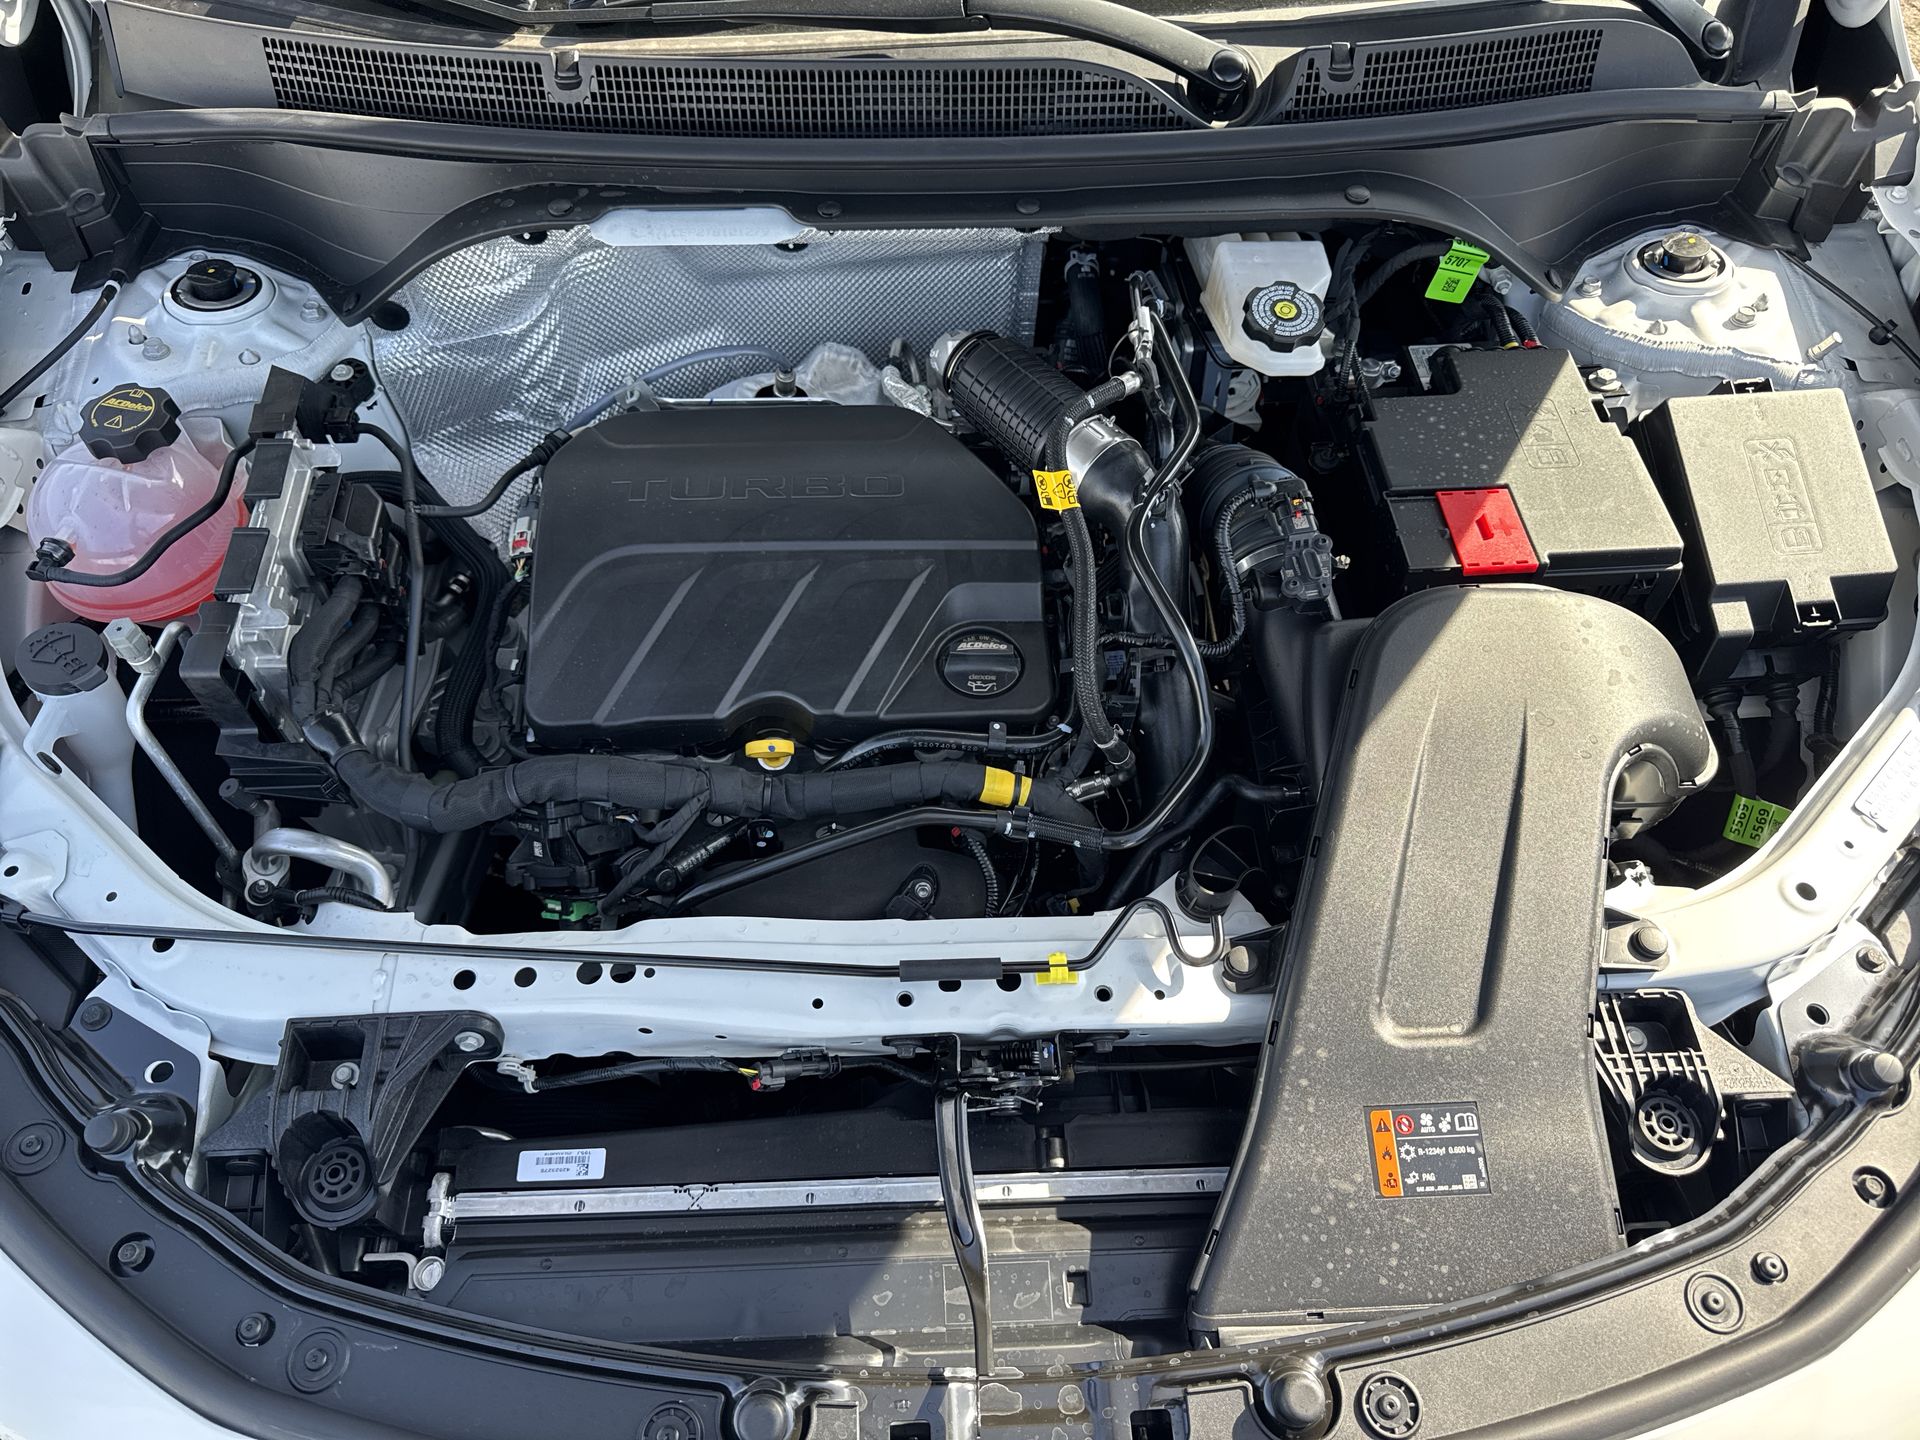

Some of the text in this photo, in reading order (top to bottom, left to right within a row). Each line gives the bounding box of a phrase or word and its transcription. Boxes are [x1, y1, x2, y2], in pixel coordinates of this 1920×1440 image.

[1444, 255, 1471, 268] 5707
[102, 397, 153, 412] ACDelco
[611, 475, 905, 501] TURBO
[956, 641, 1008, 651] ACDelco
[968, 673, 997, 681] dexos
[1749, 808, 1770, 842] 5569
[1420, 1125, 1436, 1134] AUTO
[1417, 1147, 1446, 1156] R-1234yf
[1466, 1145, 1476, 1155] kg
[1421, 1172, 1436, 1182] PAG
